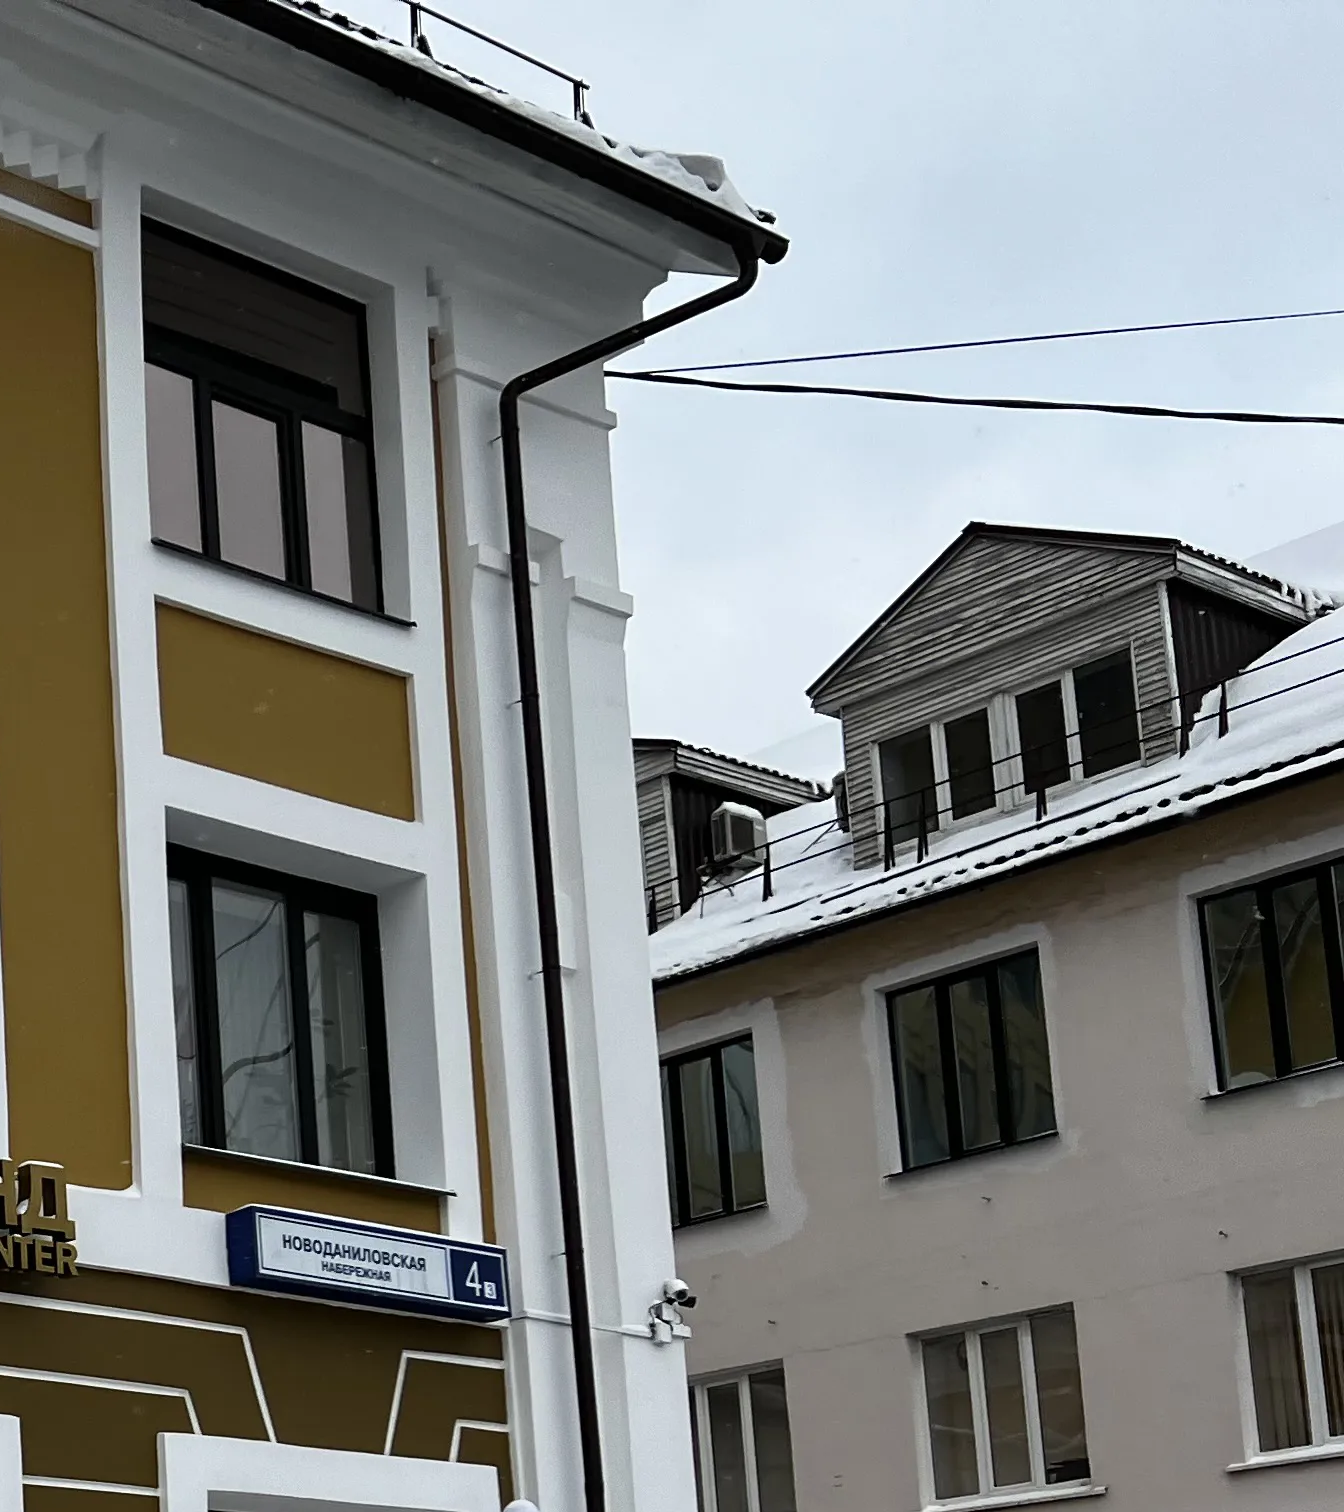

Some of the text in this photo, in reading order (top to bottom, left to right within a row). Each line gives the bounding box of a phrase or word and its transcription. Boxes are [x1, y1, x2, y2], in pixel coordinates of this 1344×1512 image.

[282, 1234, 426, 1272] НОВОДАНИЛОВСКАЯ
[321, 1260, 392, 1282] НАБЕРЕЖНАЯ
[465, 1261, 482, 1297] 4
